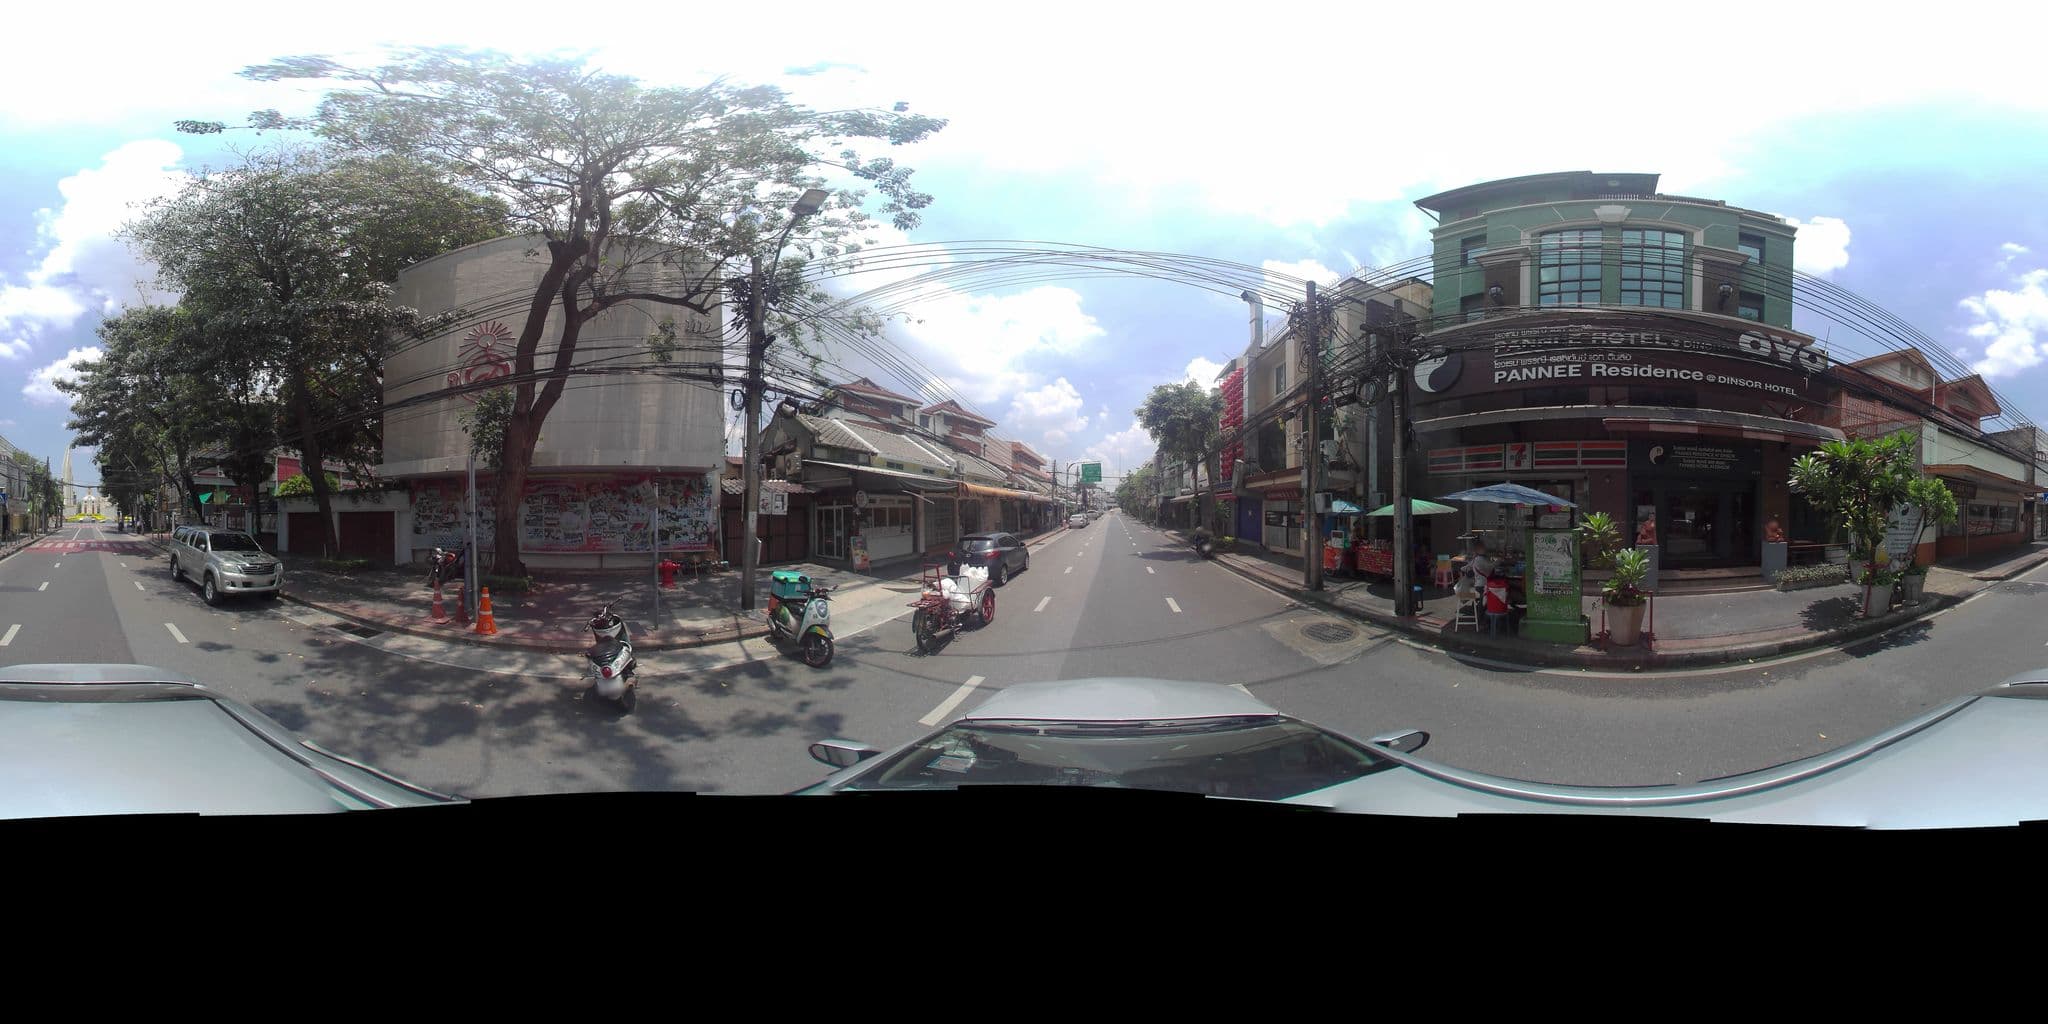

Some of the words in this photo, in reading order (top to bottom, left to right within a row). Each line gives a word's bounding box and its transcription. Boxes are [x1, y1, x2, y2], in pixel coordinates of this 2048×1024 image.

[1591, 332, 1667, 346] HOTEL
[1739, 330, 1828, 373] OYO
[1494, 364, 1582, 384] PANNEE
[1591, 363, 1704, 381] Residence
[1718, 375, 1762, 390] DINSOR
[1764, 383, 1797, 396] HOTEL
